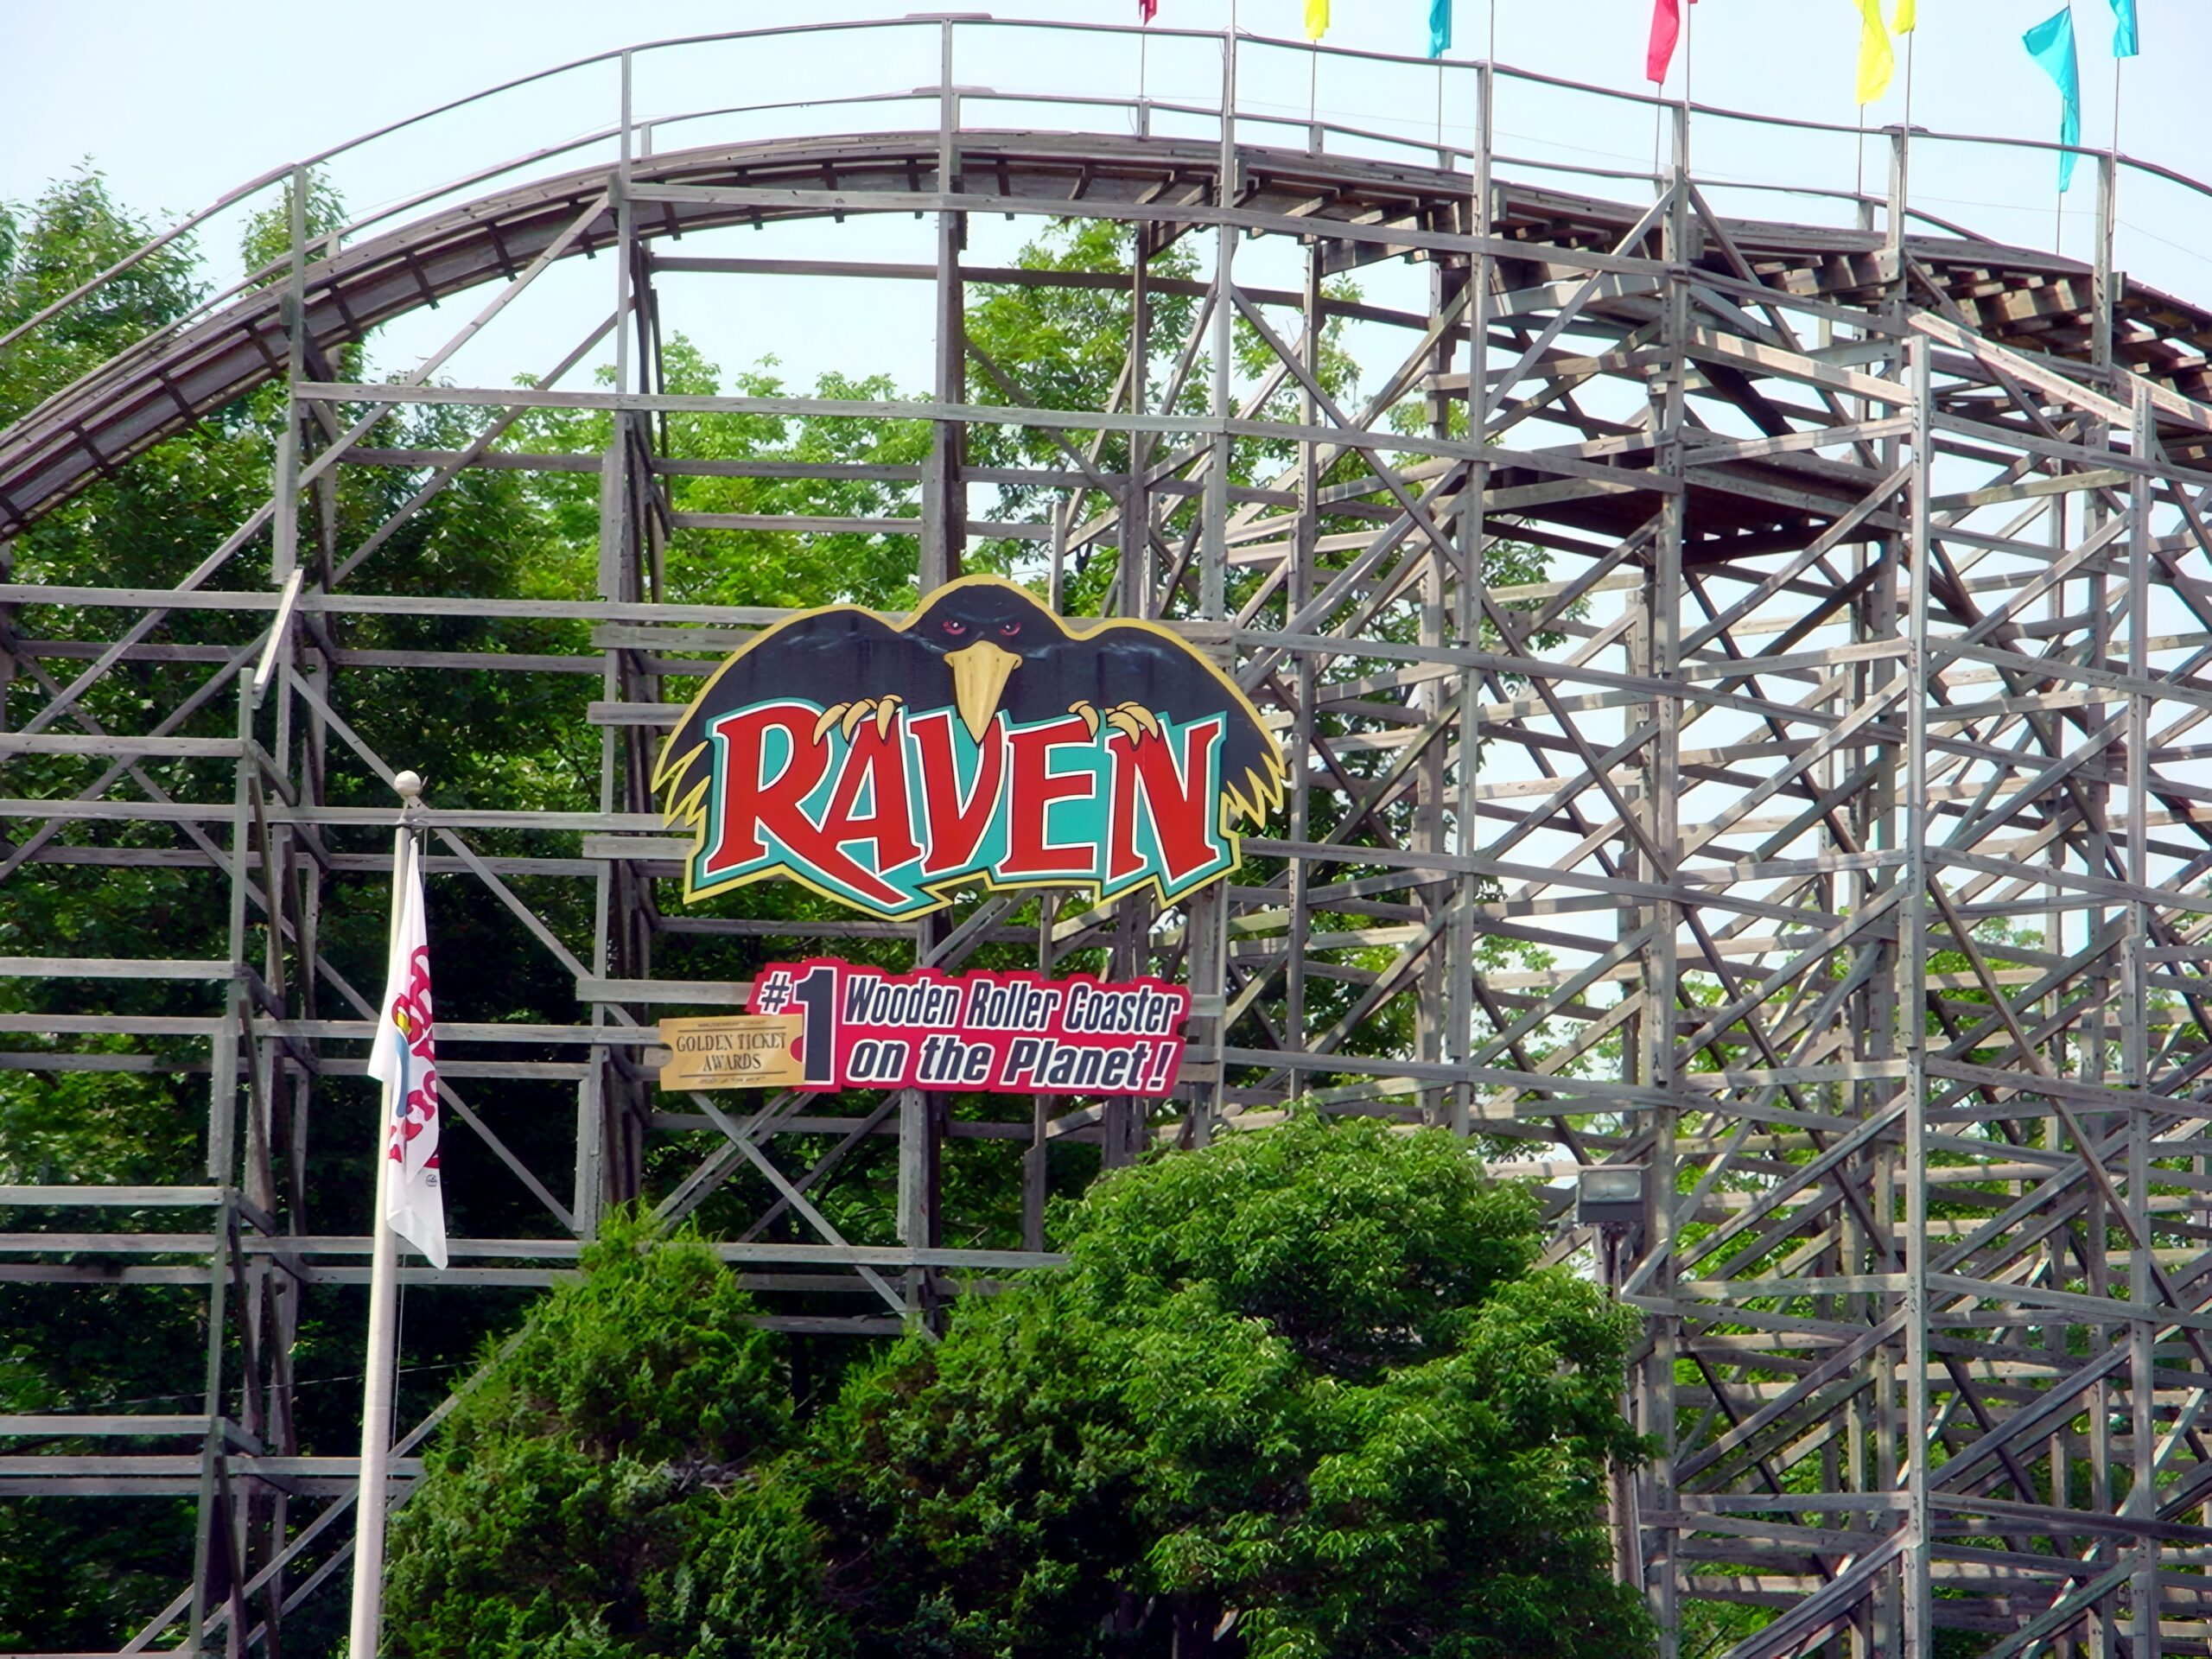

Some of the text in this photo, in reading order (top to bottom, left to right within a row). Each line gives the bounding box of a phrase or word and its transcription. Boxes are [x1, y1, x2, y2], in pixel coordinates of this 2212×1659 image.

[704, 702, 1226, 906] RAVEN
[677, 1032, 786, 1052] GOLDEN TICKET
[758, 967, 1183, 1084] #1 Wooden Roller Coaster
[702, 1053, 762, 1072] AWARDS
[846, 1034, 1177, 1091] on the Planet!
